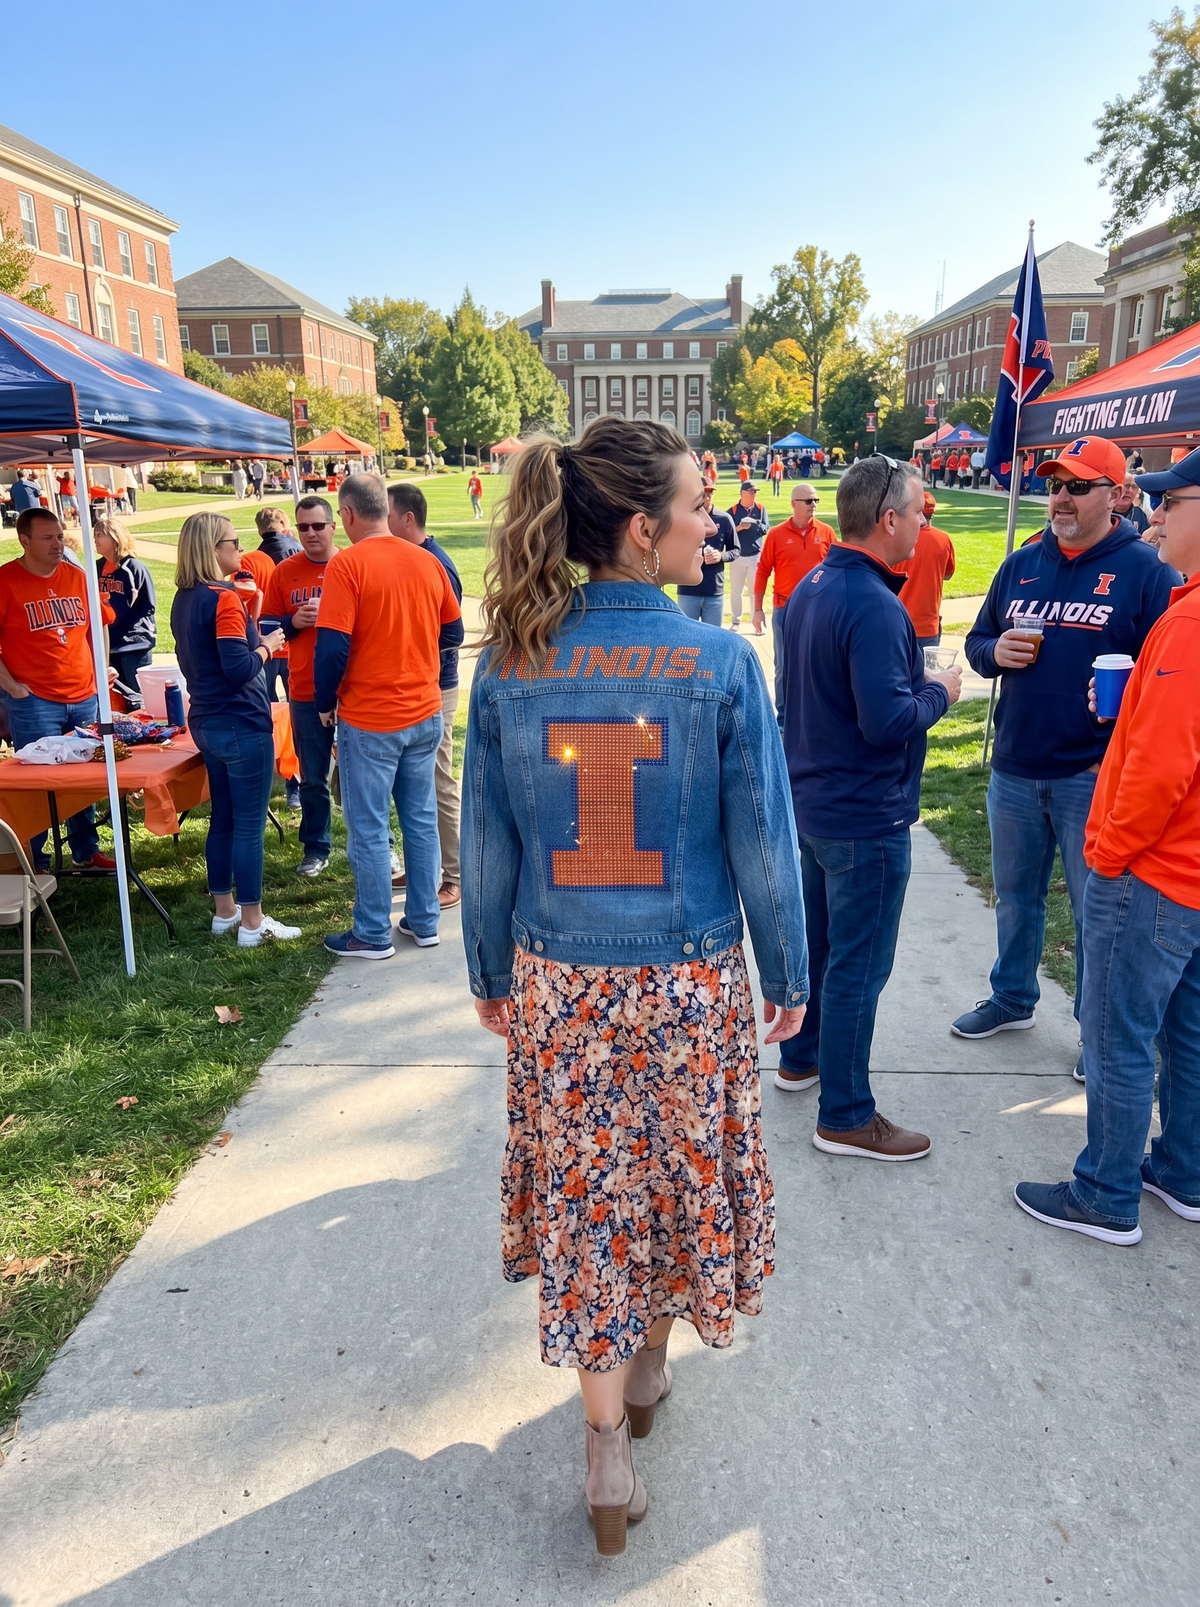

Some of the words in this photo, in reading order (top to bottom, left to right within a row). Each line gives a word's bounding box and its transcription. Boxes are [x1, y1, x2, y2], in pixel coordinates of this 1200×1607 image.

[1052, 398, 1122, 435] FIGHTING
[1120, 390, 1178, 427] ILLINI
[1066, 439, 1090, 457] I
[1093, 573, 1116, 595] I
[24, 597, 86, 632] ILLINOIS
[1006, 599, 1114, 625] ILLINOIS
[498, 646, 701, 680] ILLINOIS
[541, 716, 669, 892] I
